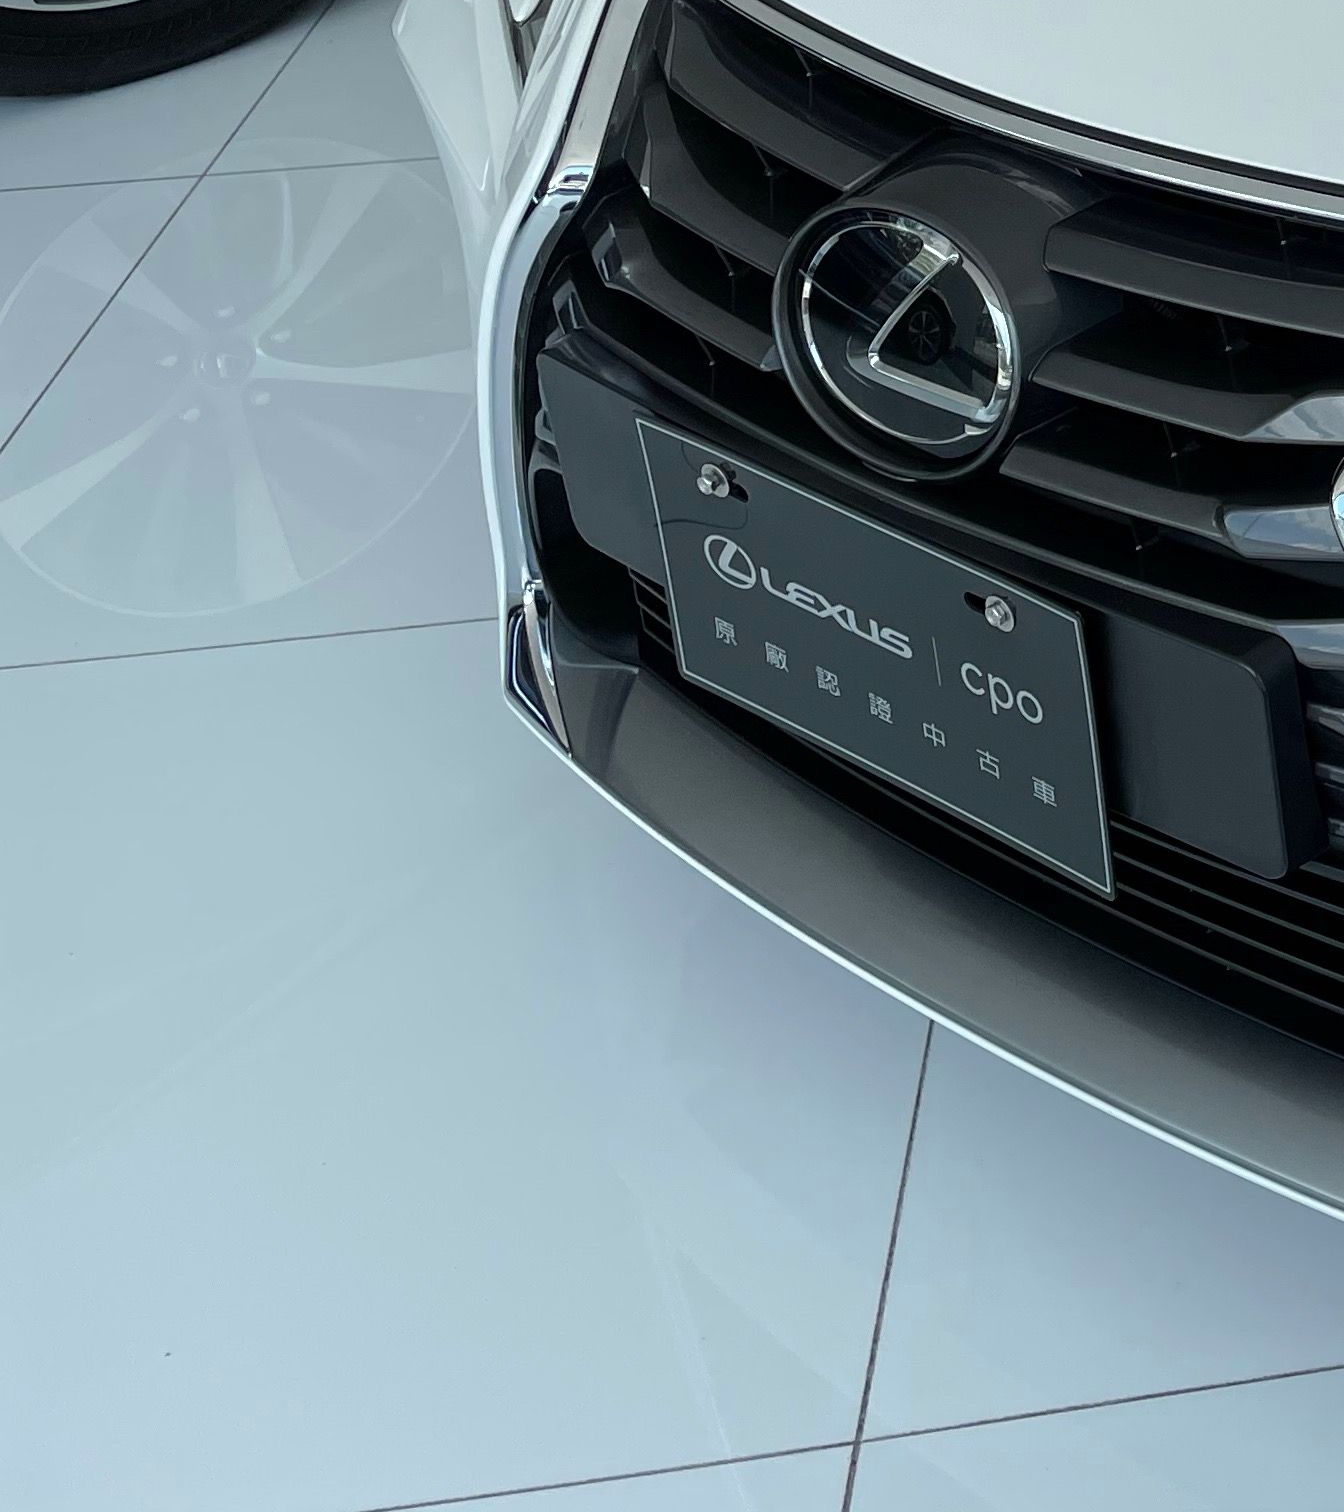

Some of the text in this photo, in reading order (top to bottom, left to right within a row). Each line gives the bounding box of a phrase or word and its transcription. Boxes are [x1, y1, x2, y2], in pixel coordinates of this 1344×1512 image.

[715, 616, 1057, 807] 原廠認證中古車
[760, 566, 913, 659] LEXUS
[961, 662, 1043, 724] cpo
